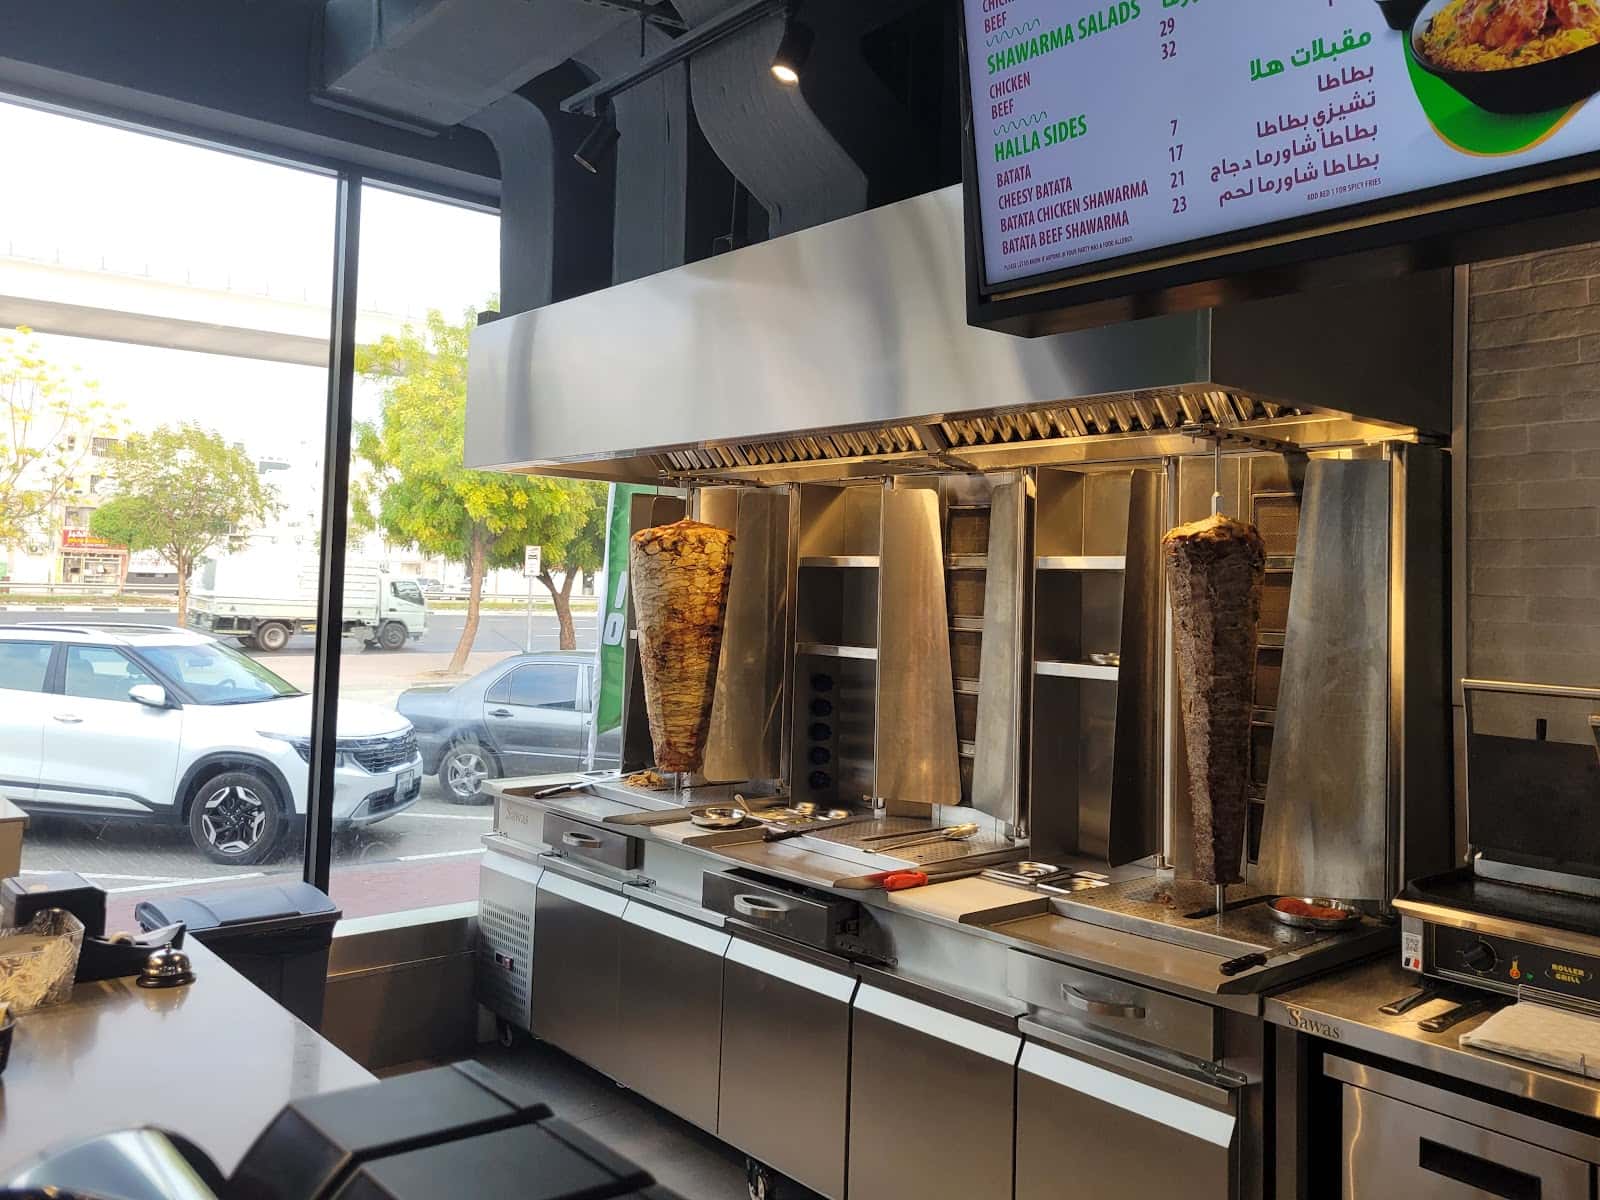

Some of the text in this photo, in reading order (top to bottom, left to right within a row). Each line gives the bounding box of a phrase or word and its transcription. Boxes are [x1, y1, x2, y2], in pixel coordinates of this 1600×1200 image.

[984, 11, 1007, 34] BEEF
[1159, 17, 1175, 38] 29
[987, 0, 1141, 75] SHAWARMA SALADS
[1161, 40, 1177, 60] 32
[1249, 28, 1372, 82] مقبلات هلا
[989, 71, 1031, 100] CHICKEN
[1317, 65, 1374, 92] بطاطا
[991, 98, 1014, 120] BEEF
[1256, 90, 1376, 138] تشيزي بطاطا
[994, 114, 1087, 162] HALLA SIDES
[1169, 119, 1178, 137] 7
[1168, 144, 1184, 163] 17
[1210, 124, 1378, 182] بطاطا شاورما دجاج
[996, 163, 1032, 188] BATATA
[1169, 169, 1185, 189] 21
[1219, 152, 1380, 208] بطاطا شاورما لحم
[1335, 185, 1347, 194] FOR
[1364, 177, 1382, 187] FRIES
[998, 176, 1073, 210] CHEESY BATATA
[1000, 179, 1149, 233] BATATA CHICKEN SHAWARMA
[1172, 196, 1188, 215] 23
[1002, 209, 1130, 255] BATATA BEEF SHAWARMA
[1286, 1005, 1340, 1040] Sawas
